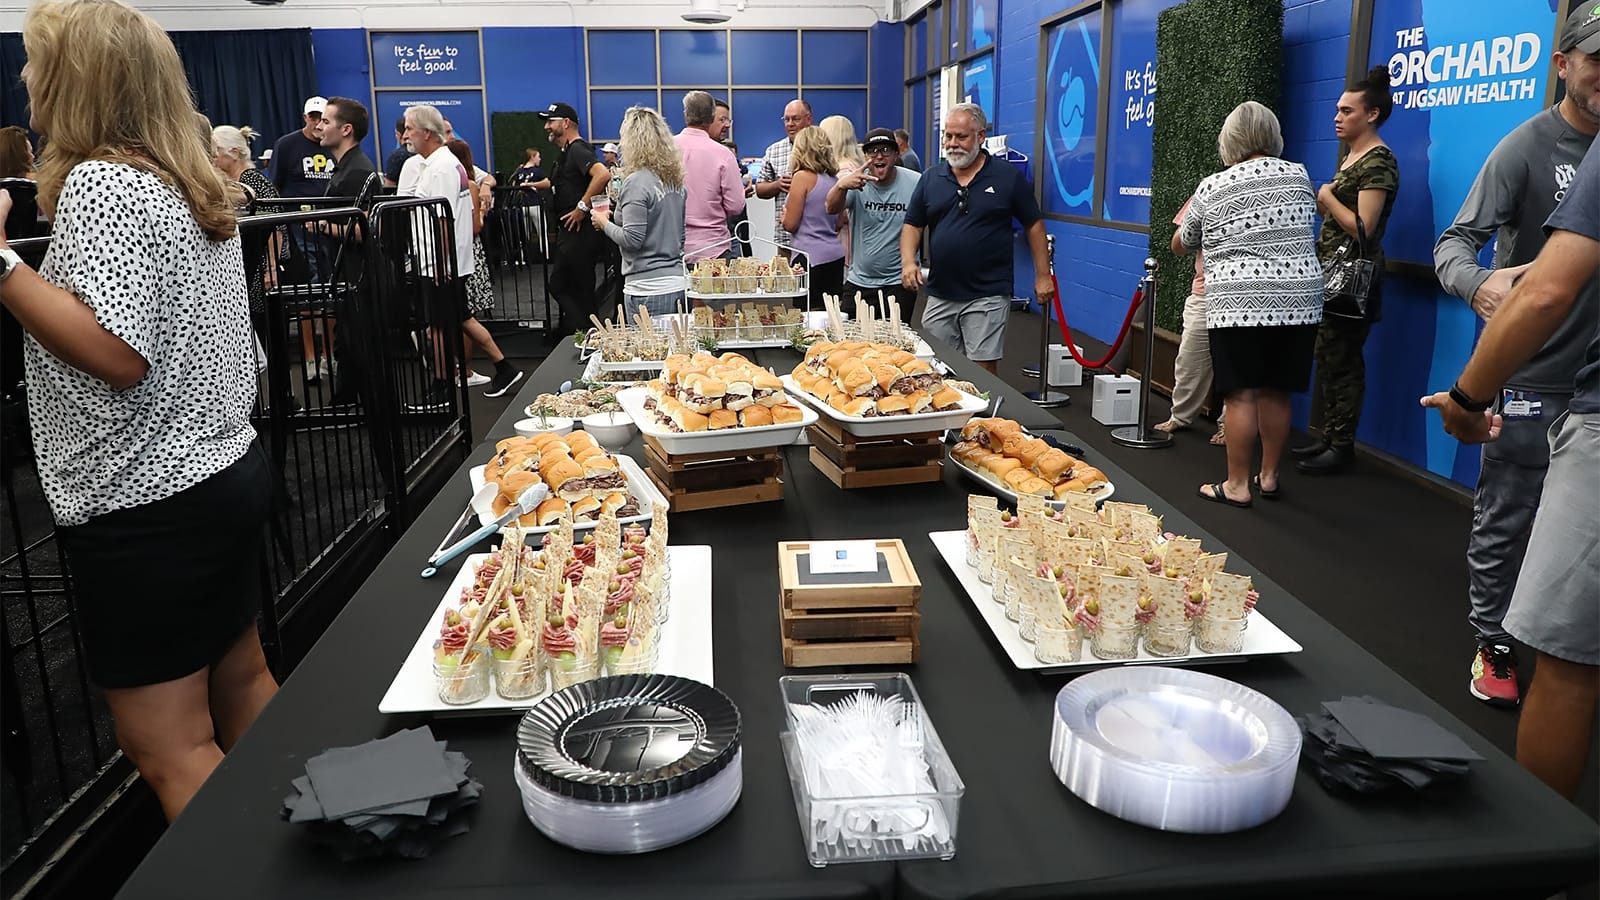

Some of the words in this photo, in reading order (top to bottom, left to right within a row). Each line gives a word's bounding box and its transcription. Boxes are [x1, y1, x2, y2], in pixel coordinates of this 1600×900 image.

[1396, 26, 1424, 49] THE
[394, 45, 414, 57] It's
[416, 43, 443, 60] fun
[445, 45, 458, 57] to
[1388, 32, 1541, 87] ORCHARD
[397, 58, 421, 75] feel
[424, 58, 457, 75] good.
[1125, 69, 1141, 91] It's
[1392, 91, 1405, 105] AT
[1404, 85, 1463, 109] JIGSAW
[1464, 78, 1536, 104] HEALTH
[1125, 96, 1144, 129] feel
[302, 154, 335, 172] PPA
